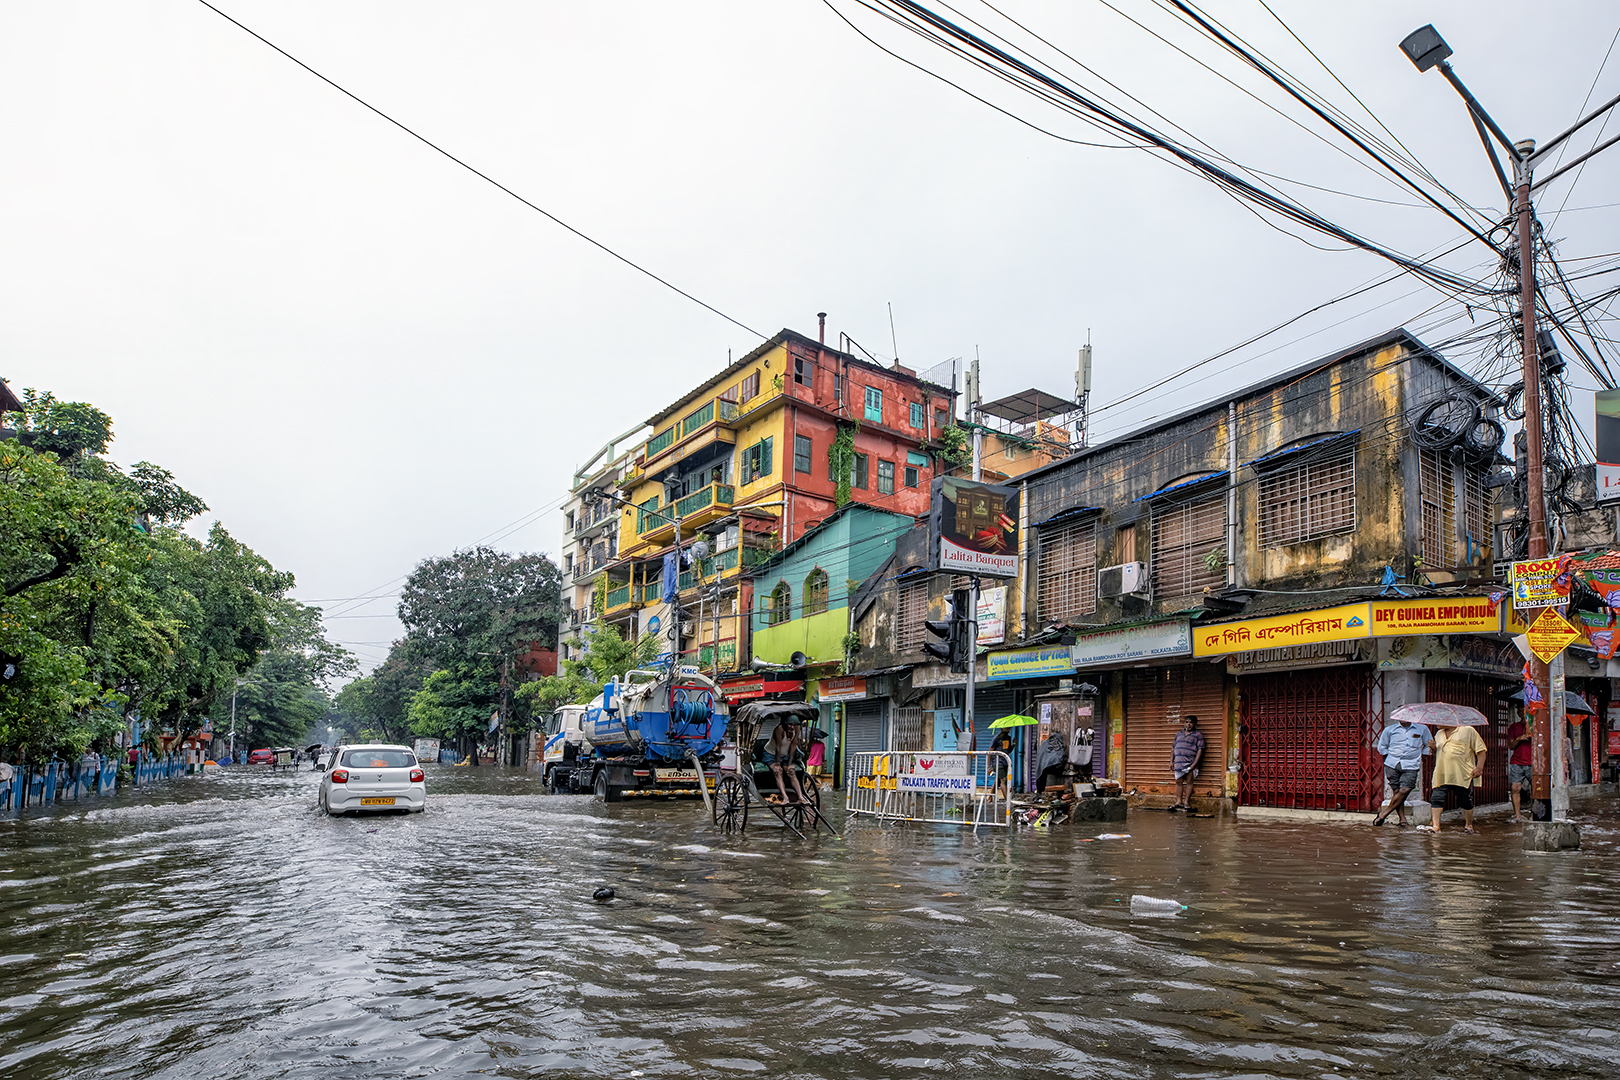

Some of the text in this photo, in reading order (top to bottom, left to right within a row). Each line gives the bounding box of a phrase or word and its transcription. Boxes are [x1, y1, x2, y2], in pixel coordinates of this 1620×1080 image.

[944, 549, 973, 562] Lalita
[975, 553, 1016, 568] Banquet
[1375, 605, 1496, 622] DEY GUINEA EMPORIUM
[1081, 621, 1178, 647] DOCTOR'S CHAMBER
[1205, 634, 1219, 648] দে
[1222, 628, 1251, 645] গিনি
[989, 655, 1009, 666] YOUR
[1009, 651, 1039, 664] CHOICE
[1256, 646, 1294, 663] GUINEA
[1294, 640, 1356, 660] EMPORIUM
[681, 667, 697, 675] KMC
[901, 777, 926, 788] KOLKATA
[927, 778, 949, 788] TRAFFIC
[950, 779, 971, 789] POLICE
